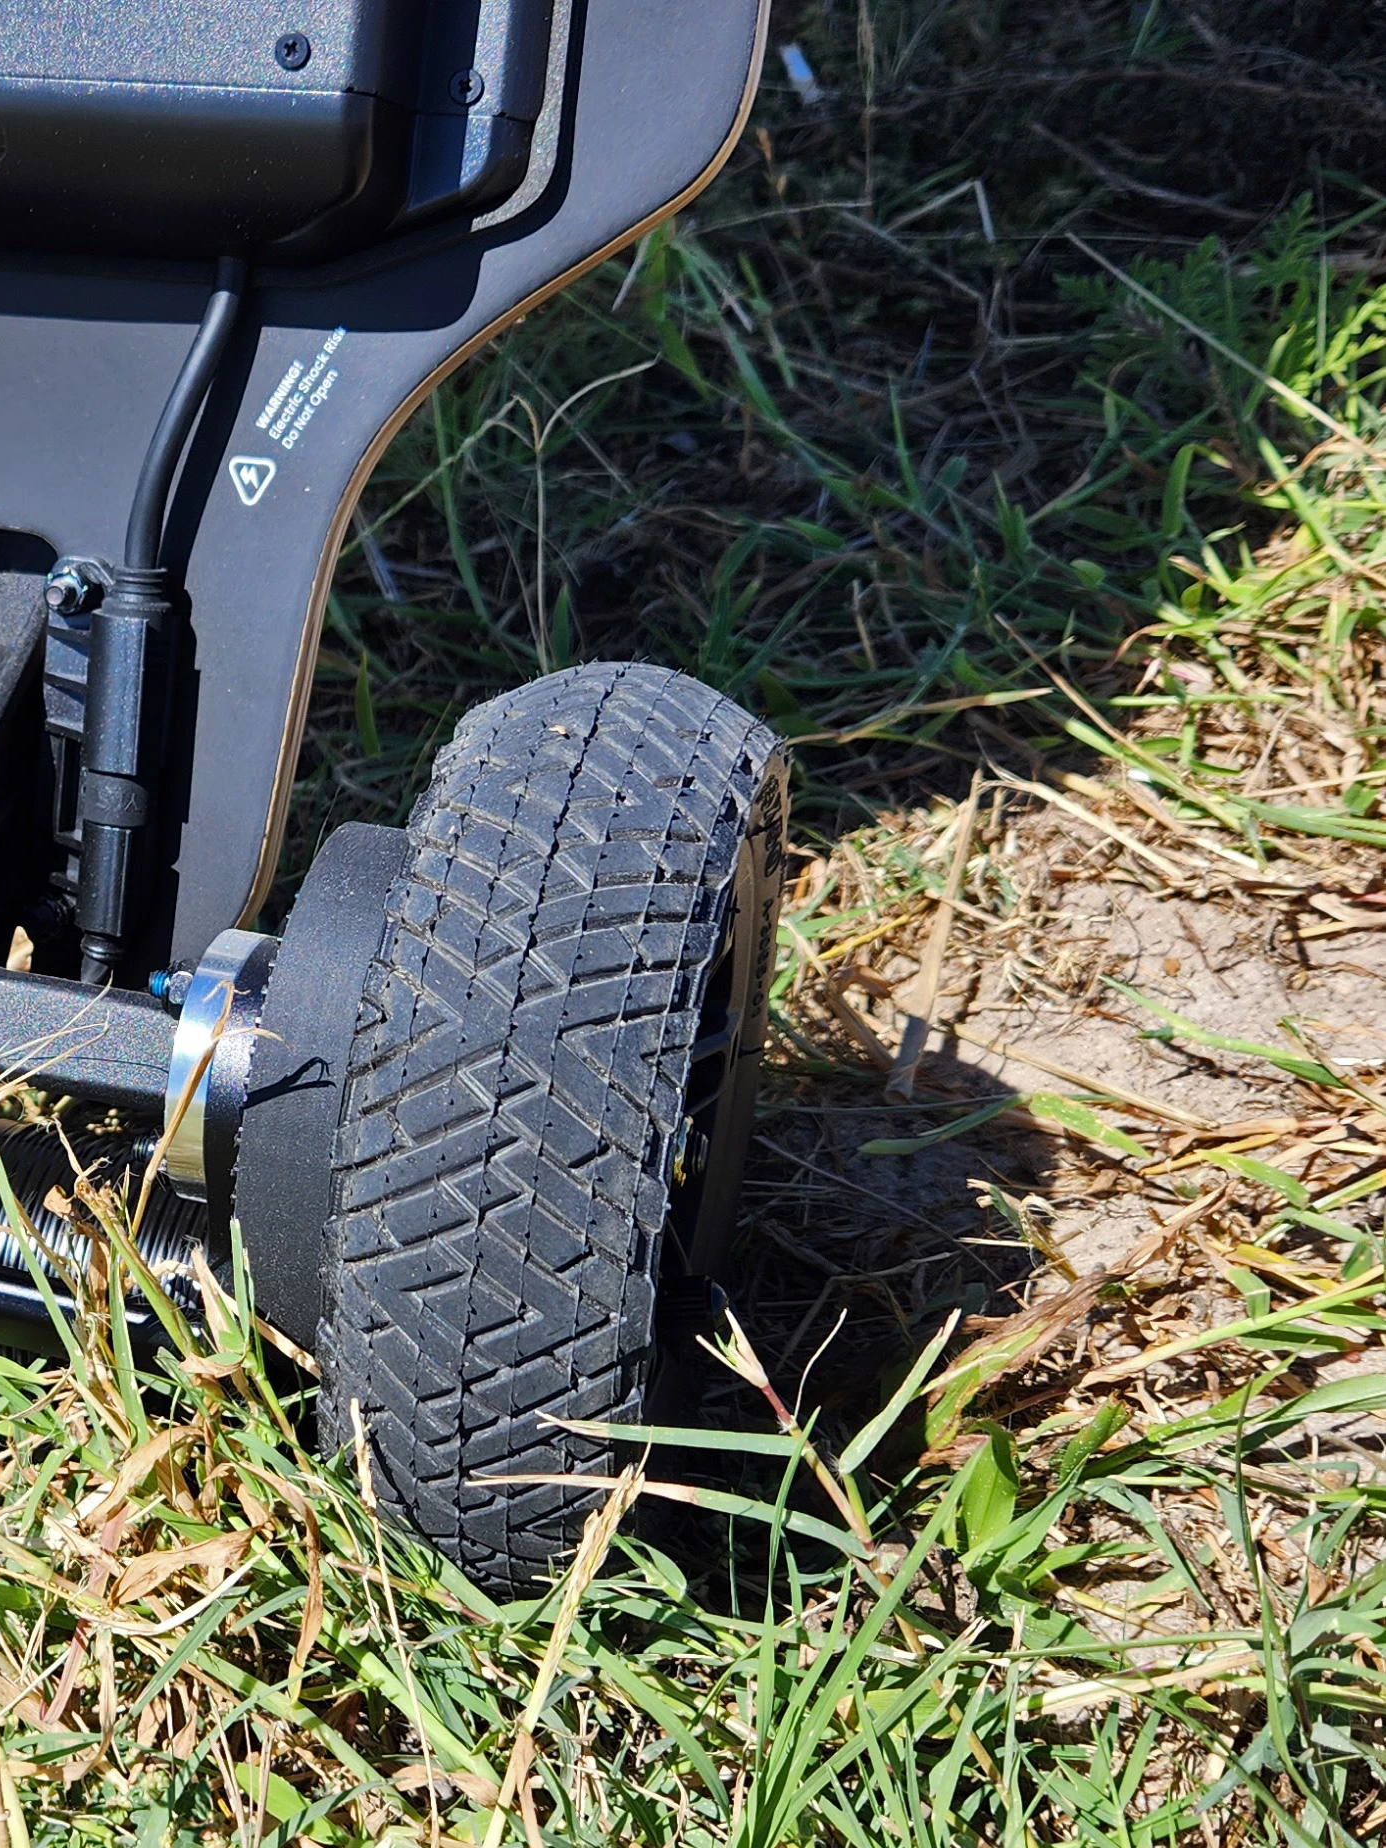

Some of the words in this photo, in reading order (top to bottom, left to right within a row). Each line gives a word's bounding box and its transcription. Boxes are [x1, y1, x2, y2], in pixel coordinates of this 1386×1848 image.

[255, 358, 304, 429] WARNING!
[269, 391, 304, 440] Electric
[298, 351, 331, 394] Shock
[281, 428, 299, 450] Do
[293, 405, 316, 432] Not
[309, 369, 339, 407] Open
